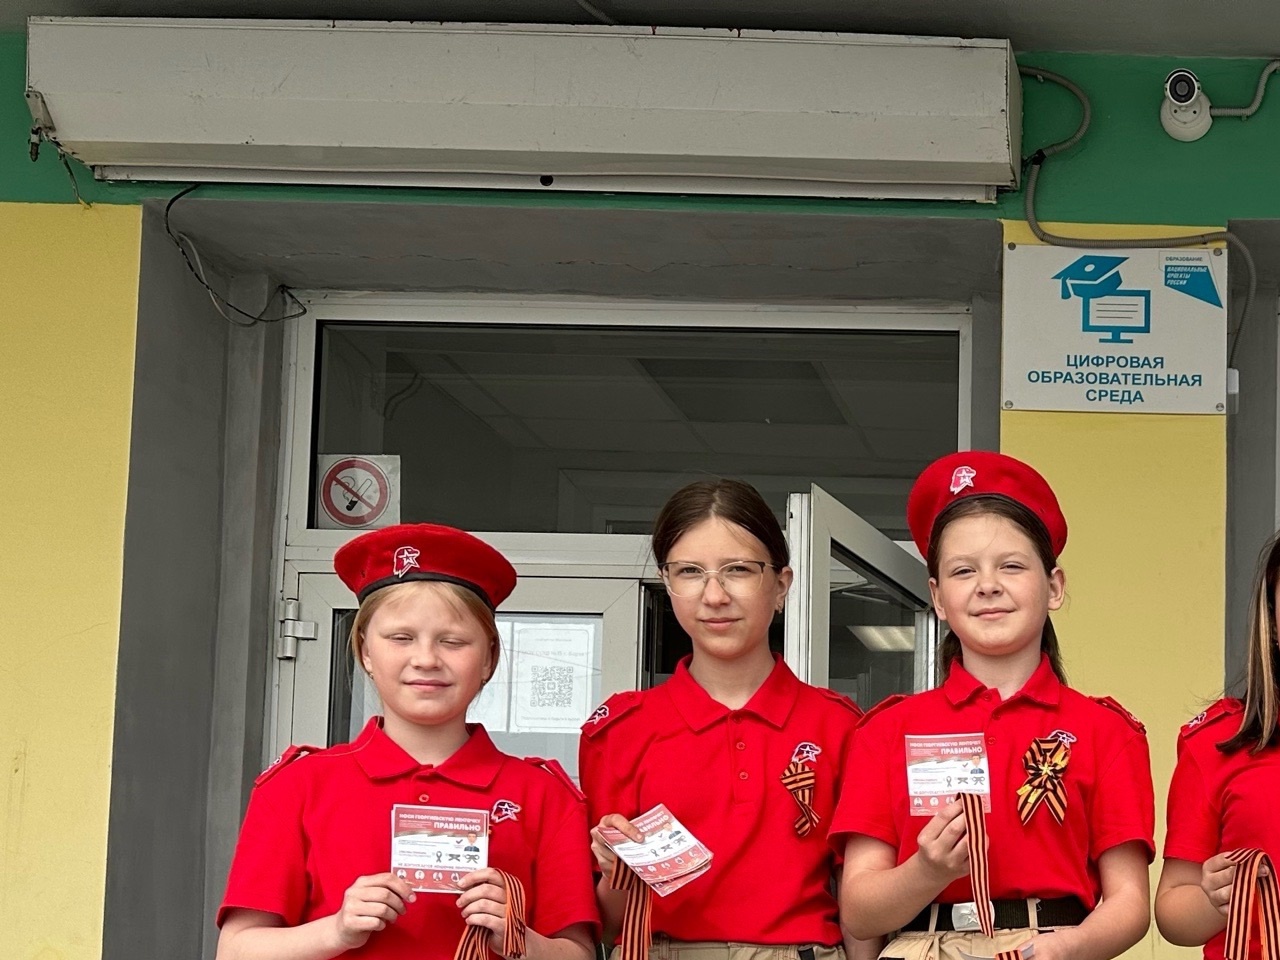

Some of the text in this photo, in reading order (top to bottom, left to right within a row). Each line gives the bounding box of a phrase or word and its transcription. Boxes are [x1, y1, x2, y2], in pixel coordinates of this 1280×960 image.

[1066, 354, 1164, 369] ЦИФРОВАЯ
[1027, 370, 1202, 386] ОБРАЗОВАТЕЛЬНАЯ
[1085, 389, 1144, 404] СРЕДА
[434, 822, 481, 831] ПРАВИЛЬНО
